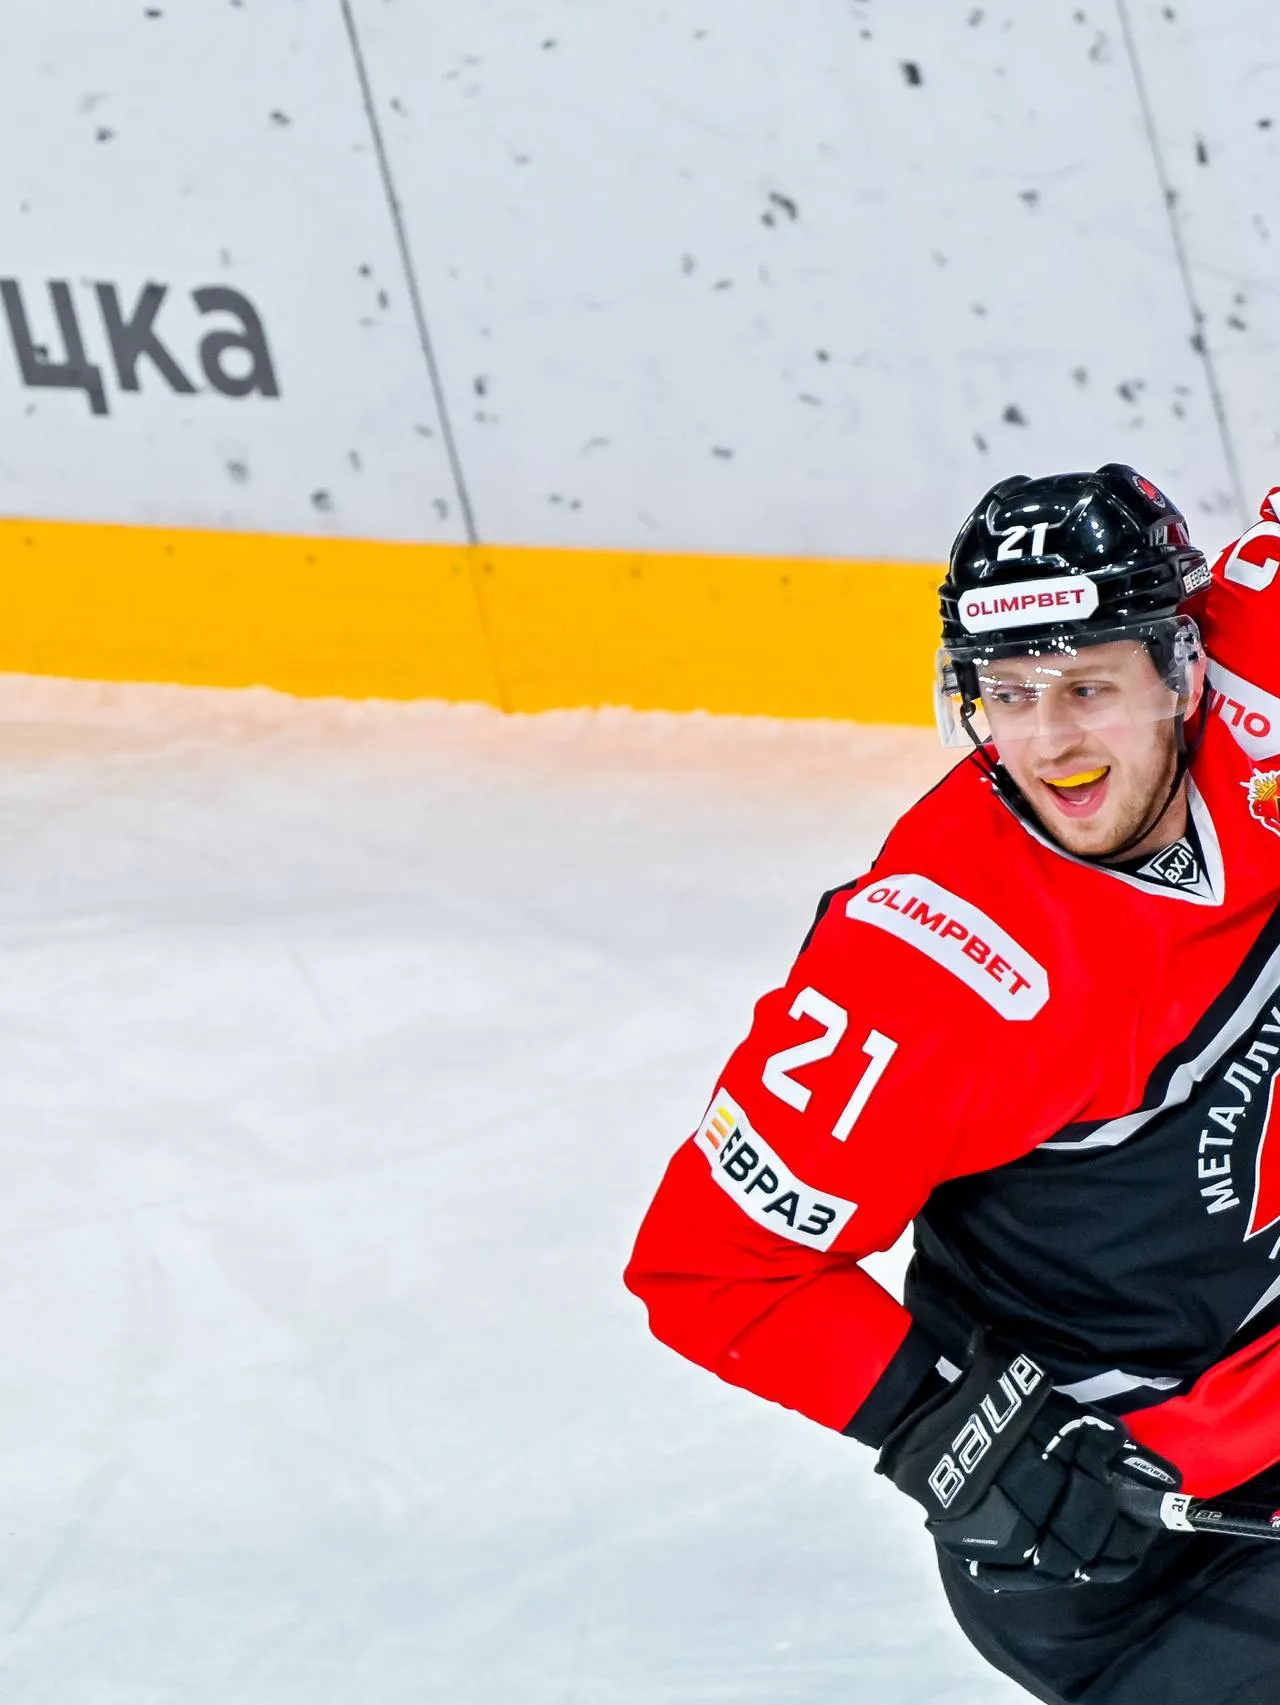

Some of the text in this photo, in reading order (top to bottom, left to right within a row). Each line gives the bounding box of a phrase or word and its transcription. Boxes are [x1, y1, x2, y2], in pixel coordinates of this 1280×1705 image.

[997, 522, 1050, 562] 21
[966, 588, 1086, 618] OLIMPBET
[866, 887, 1031, 996] OLIMPBET
[761, 985, 899, 1142] 21
